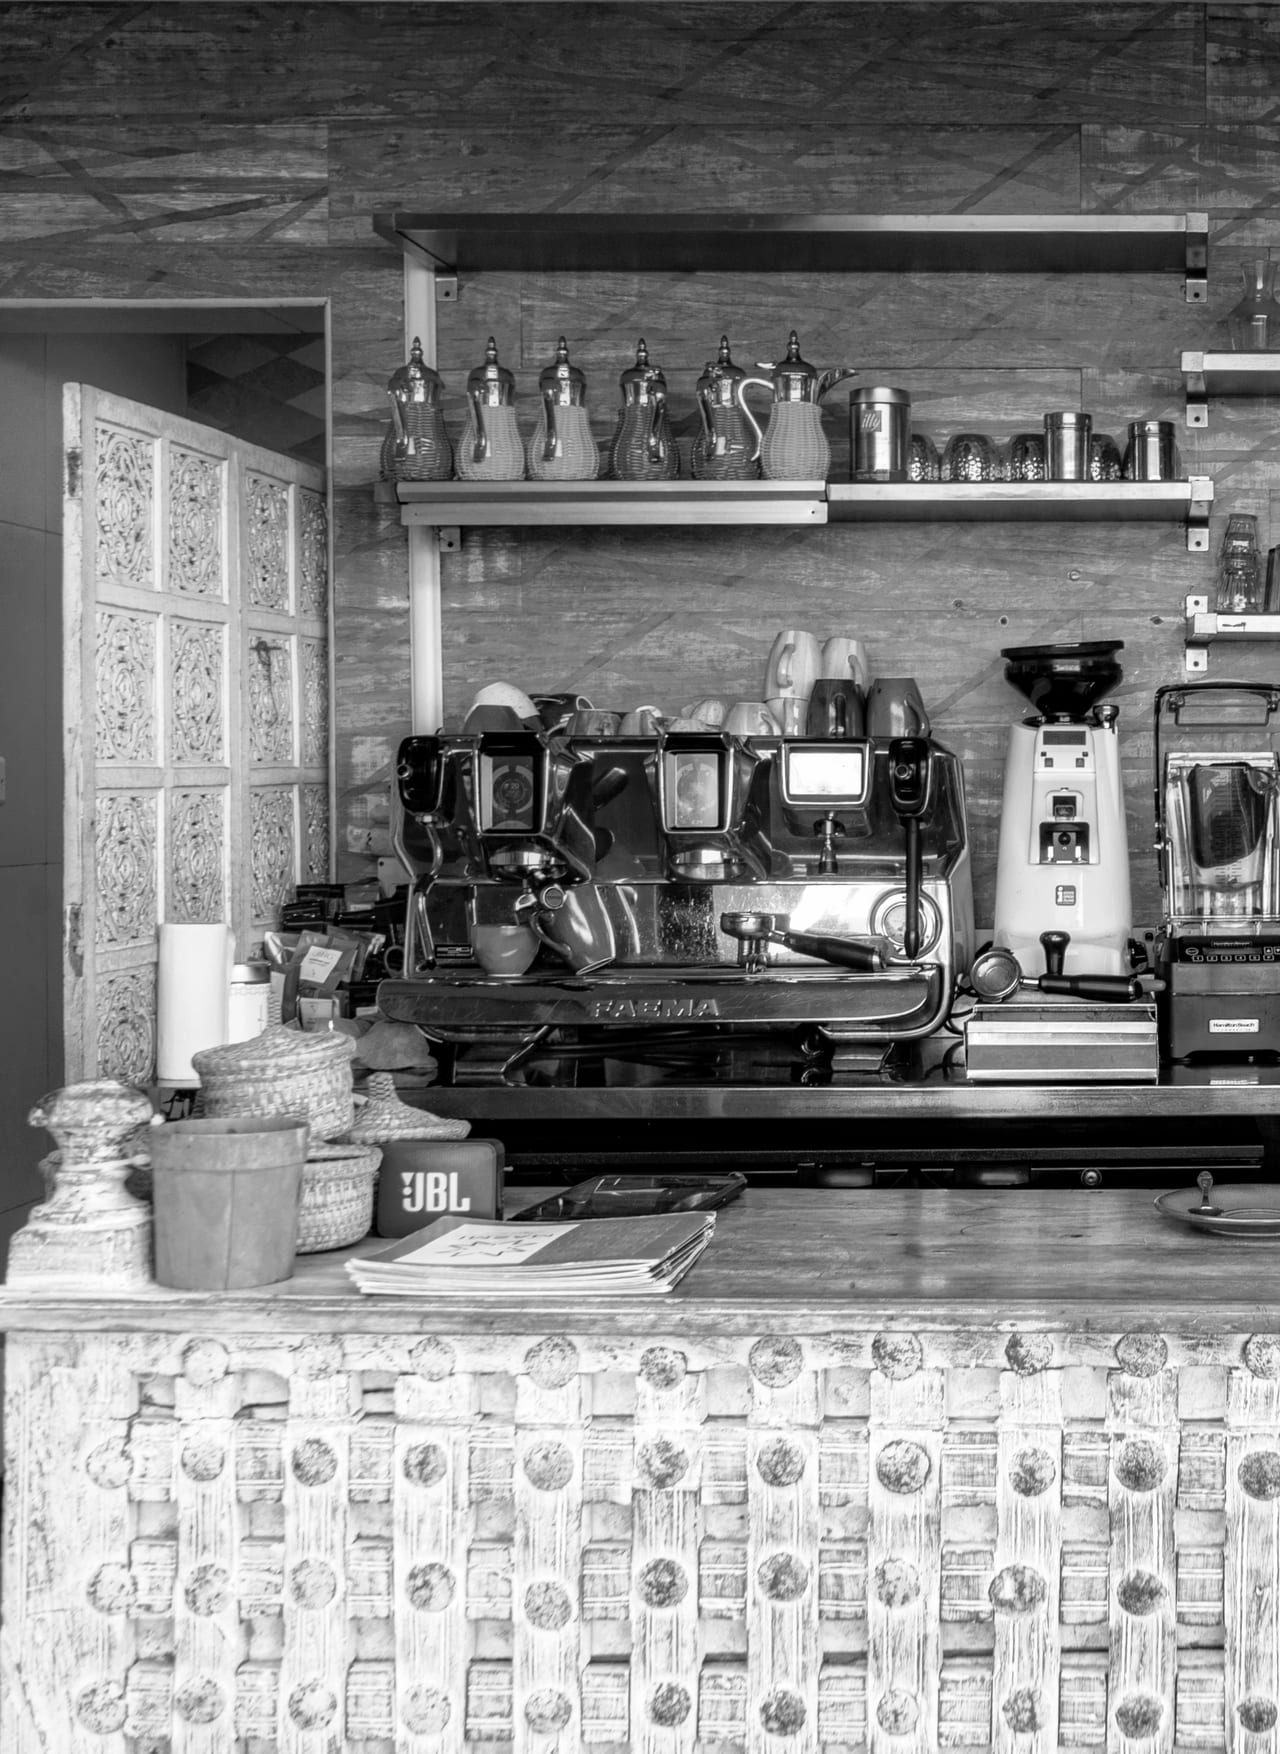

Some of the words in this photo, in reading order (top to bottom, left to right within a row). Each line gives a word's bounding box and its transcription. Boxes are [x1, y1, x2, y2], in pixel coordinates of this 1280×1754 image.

[861, 412, 881, 432] illy
[593, 998, 720, 1017] FAEMA
[401, 1172, 471, 1212] JBL
